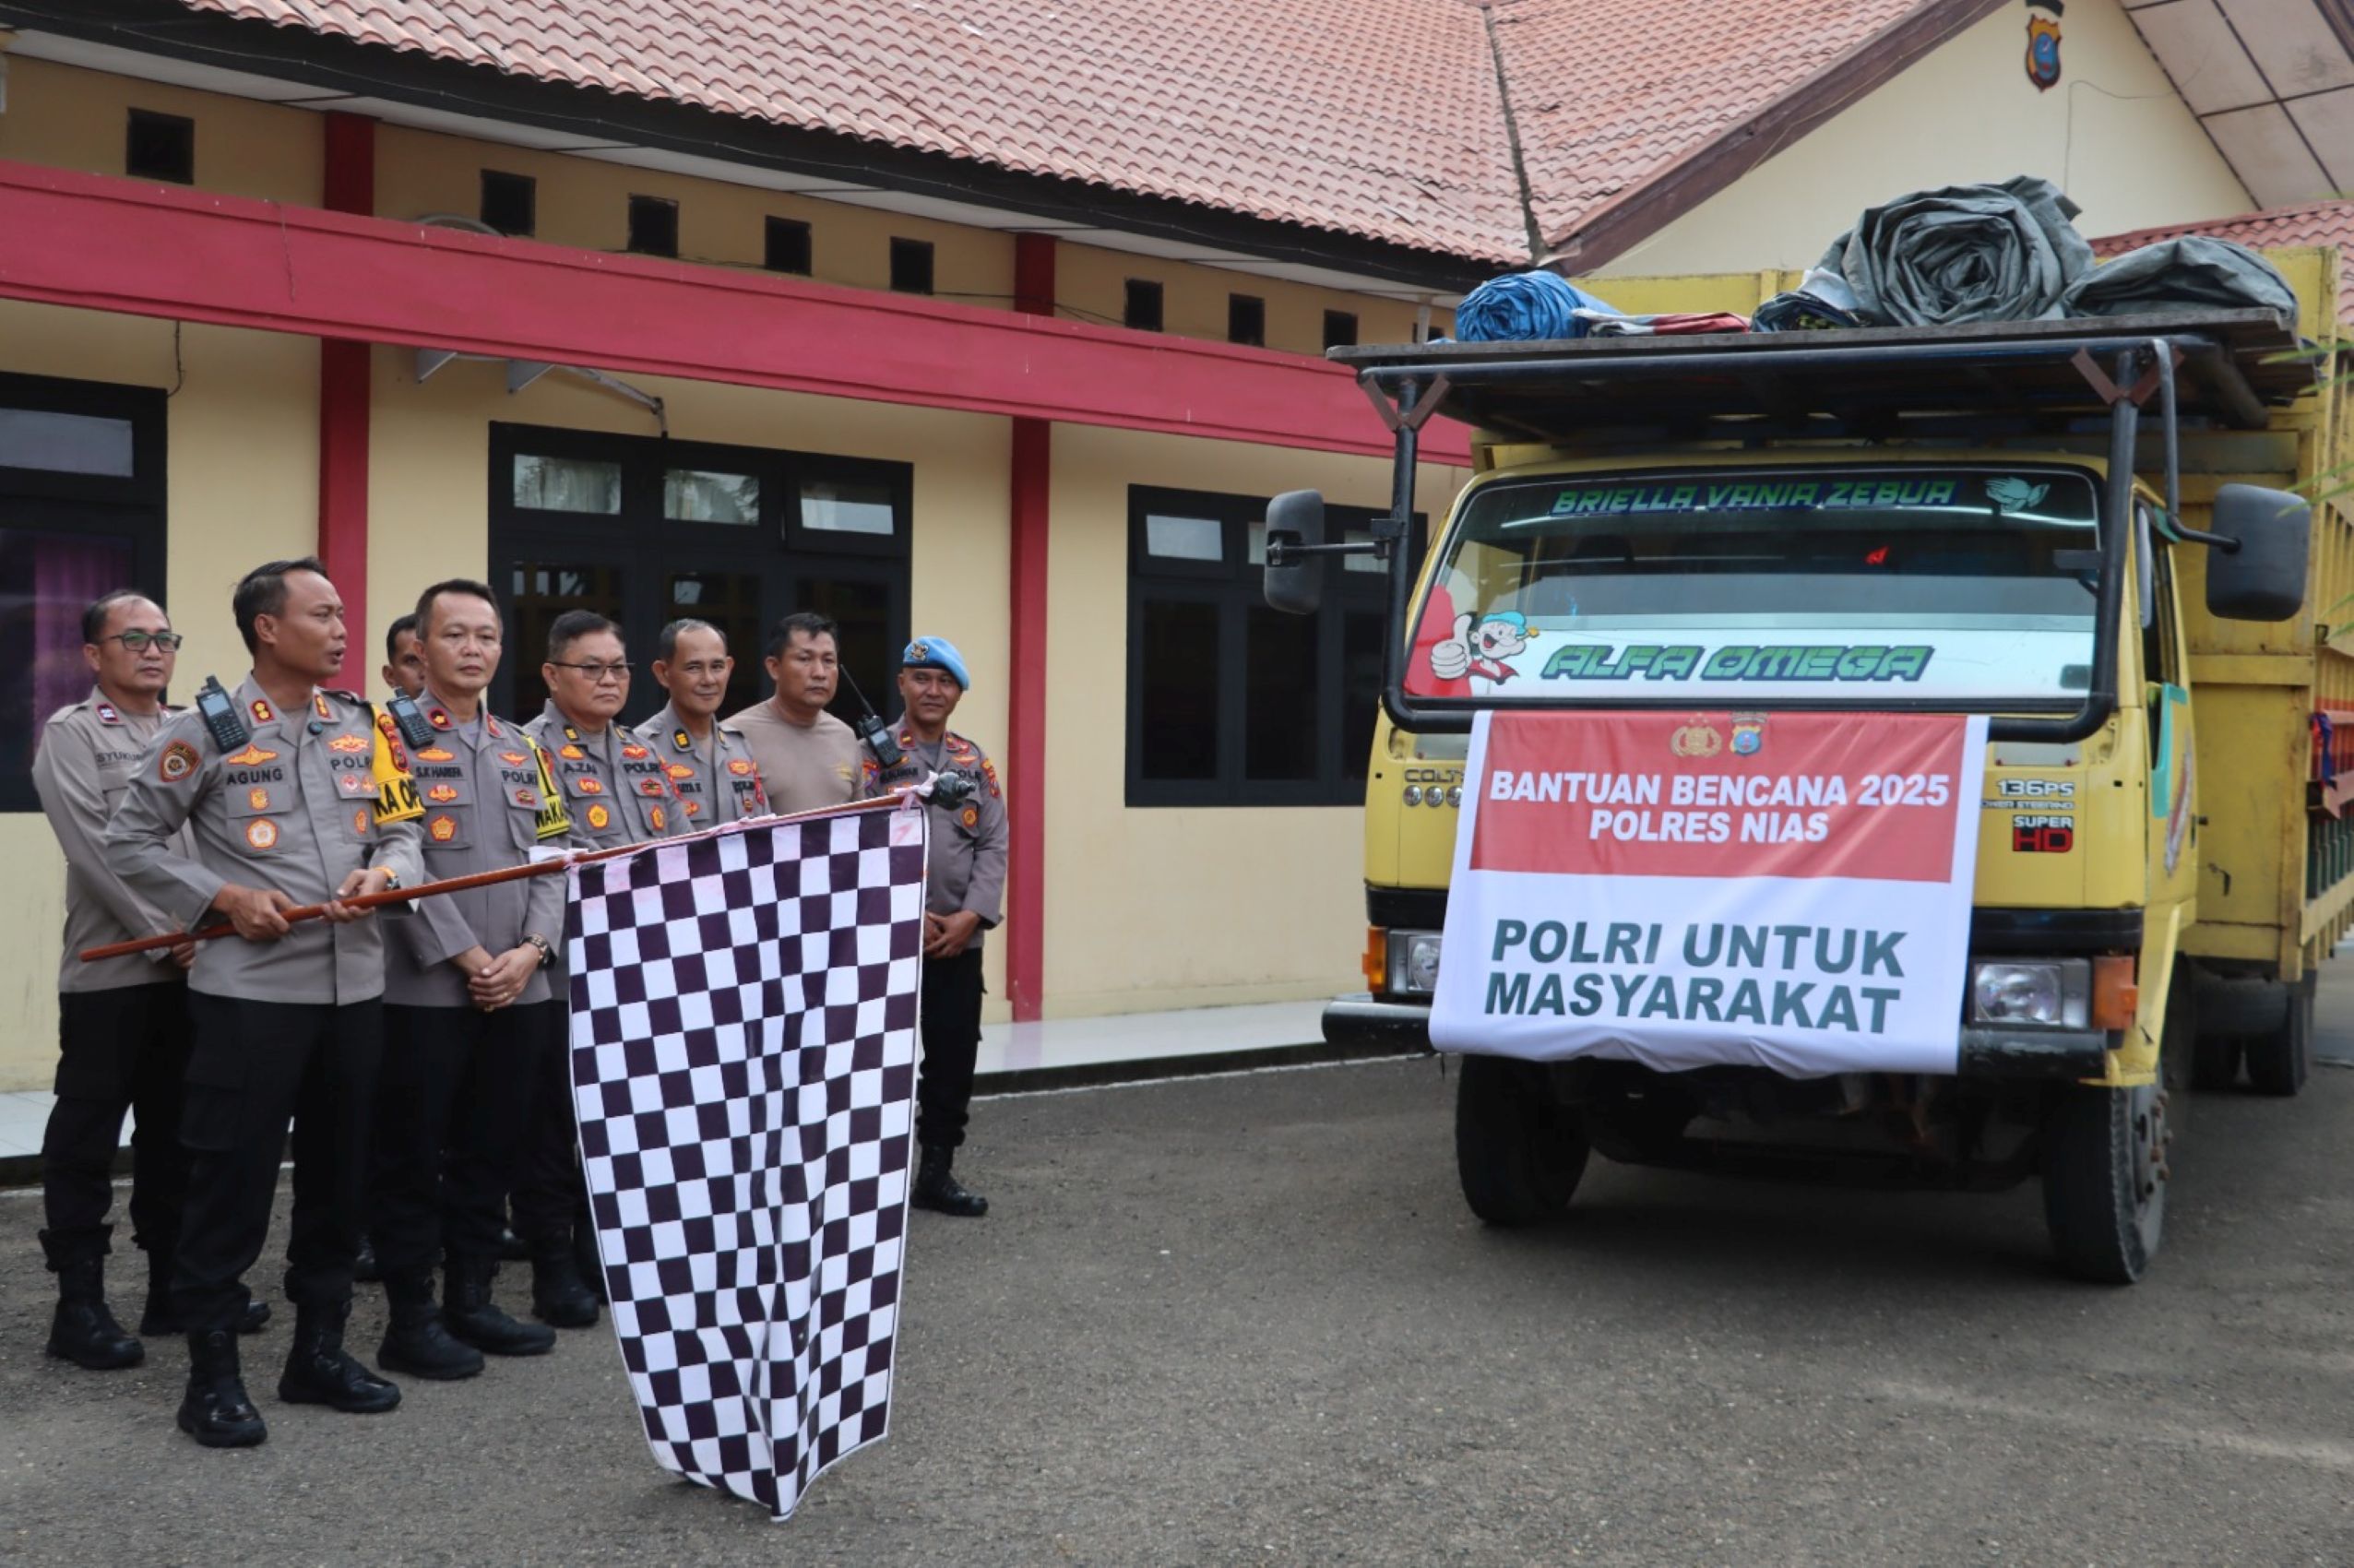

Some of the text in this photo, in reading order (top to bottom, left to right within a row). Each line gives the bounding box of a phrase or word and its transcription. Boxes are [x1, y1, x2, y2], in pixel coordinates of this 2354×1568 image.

[1551, 481, 1959, 514] BRIELLA VANIA ZEBUA
[1540, 645, 1935, 681] ALFA OMEGA
[227, 768, 284, 784] AGUNG
[502, 769, 538, 784] POLRI
[1404, 768, 1461, 783] COLT
[1996, 779, 2075, 798] 136PS
[1490, 771, 1950, 807] BANTUAN BENCANA 2025
[1980, 800, 2014, 810] OWER
[1589, 810, 1829, 844] POLRES NIAS
[2013, 815, 2074, 829] SUPER
[2013, 827, 2075, 853] HD
[1491, 919, 1909, 979] POLRI UNTUK
[1484, 971, 1901, 1035] MASYARAKAT
